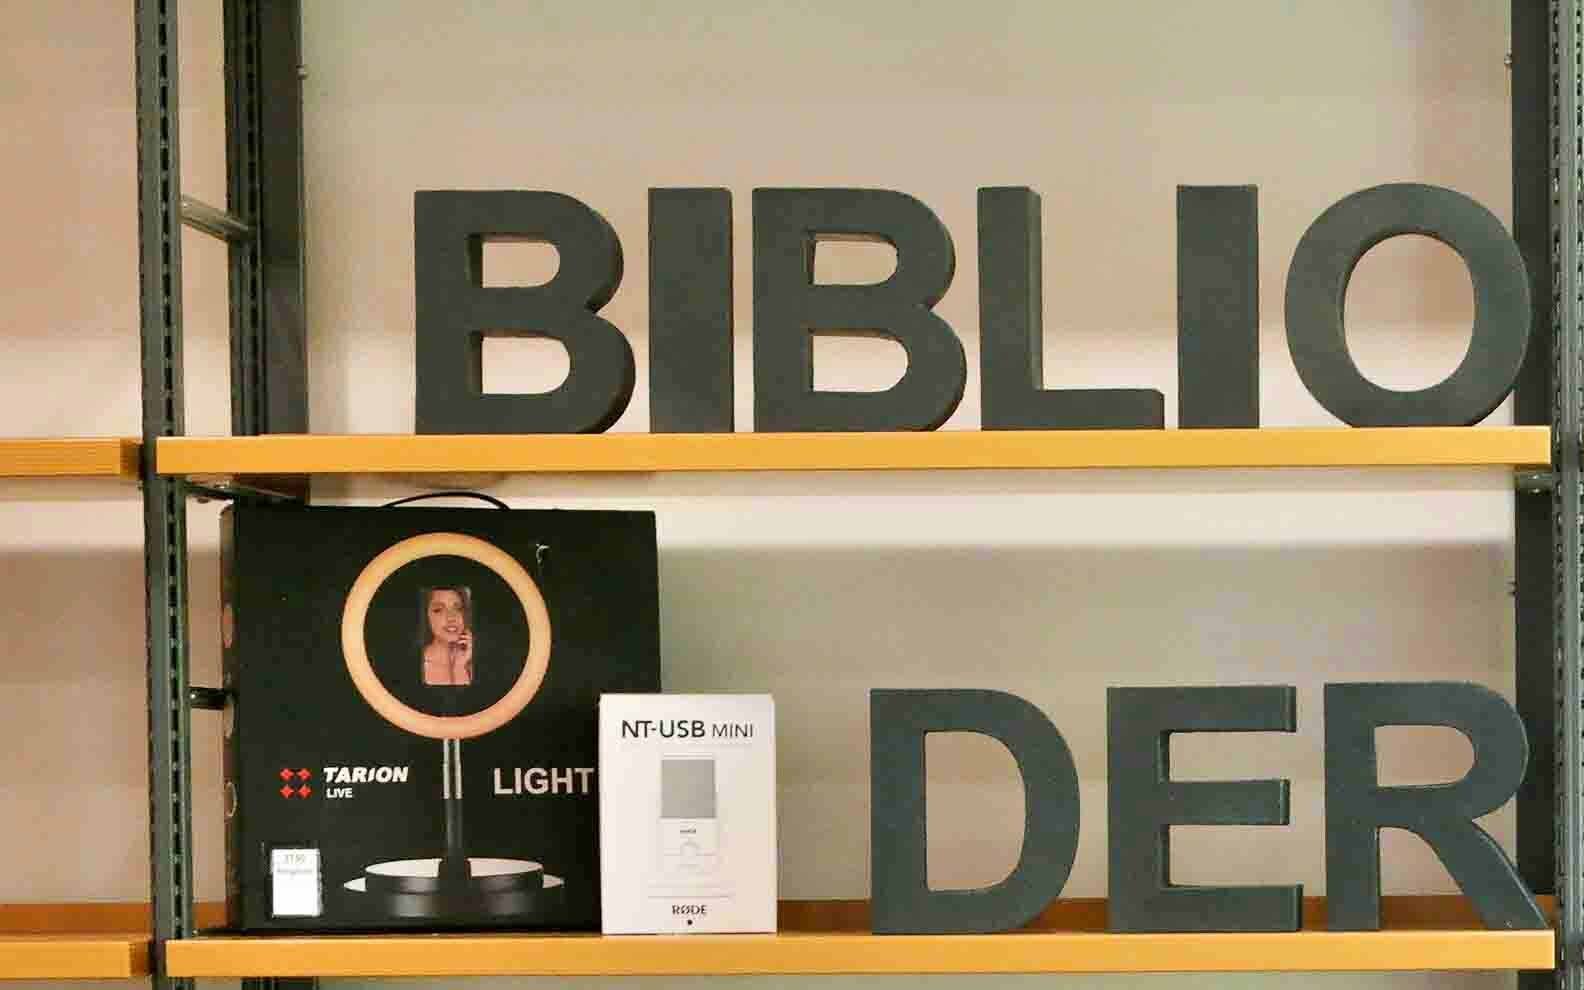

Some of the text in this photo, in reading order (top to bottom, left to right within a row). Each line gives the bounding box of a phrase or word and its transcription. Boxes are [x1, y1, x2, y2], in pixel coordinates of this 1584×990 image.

[621, 719, 754, 738] NT-USB MINI
[323, 766, 409, 783] TARION
[493, 767, 595, 795] LIGHT
[325, 787, 353, 798] LIVE
[870, 681, 1551, 934] DER
[671, 904, 708, 915] RØDE
